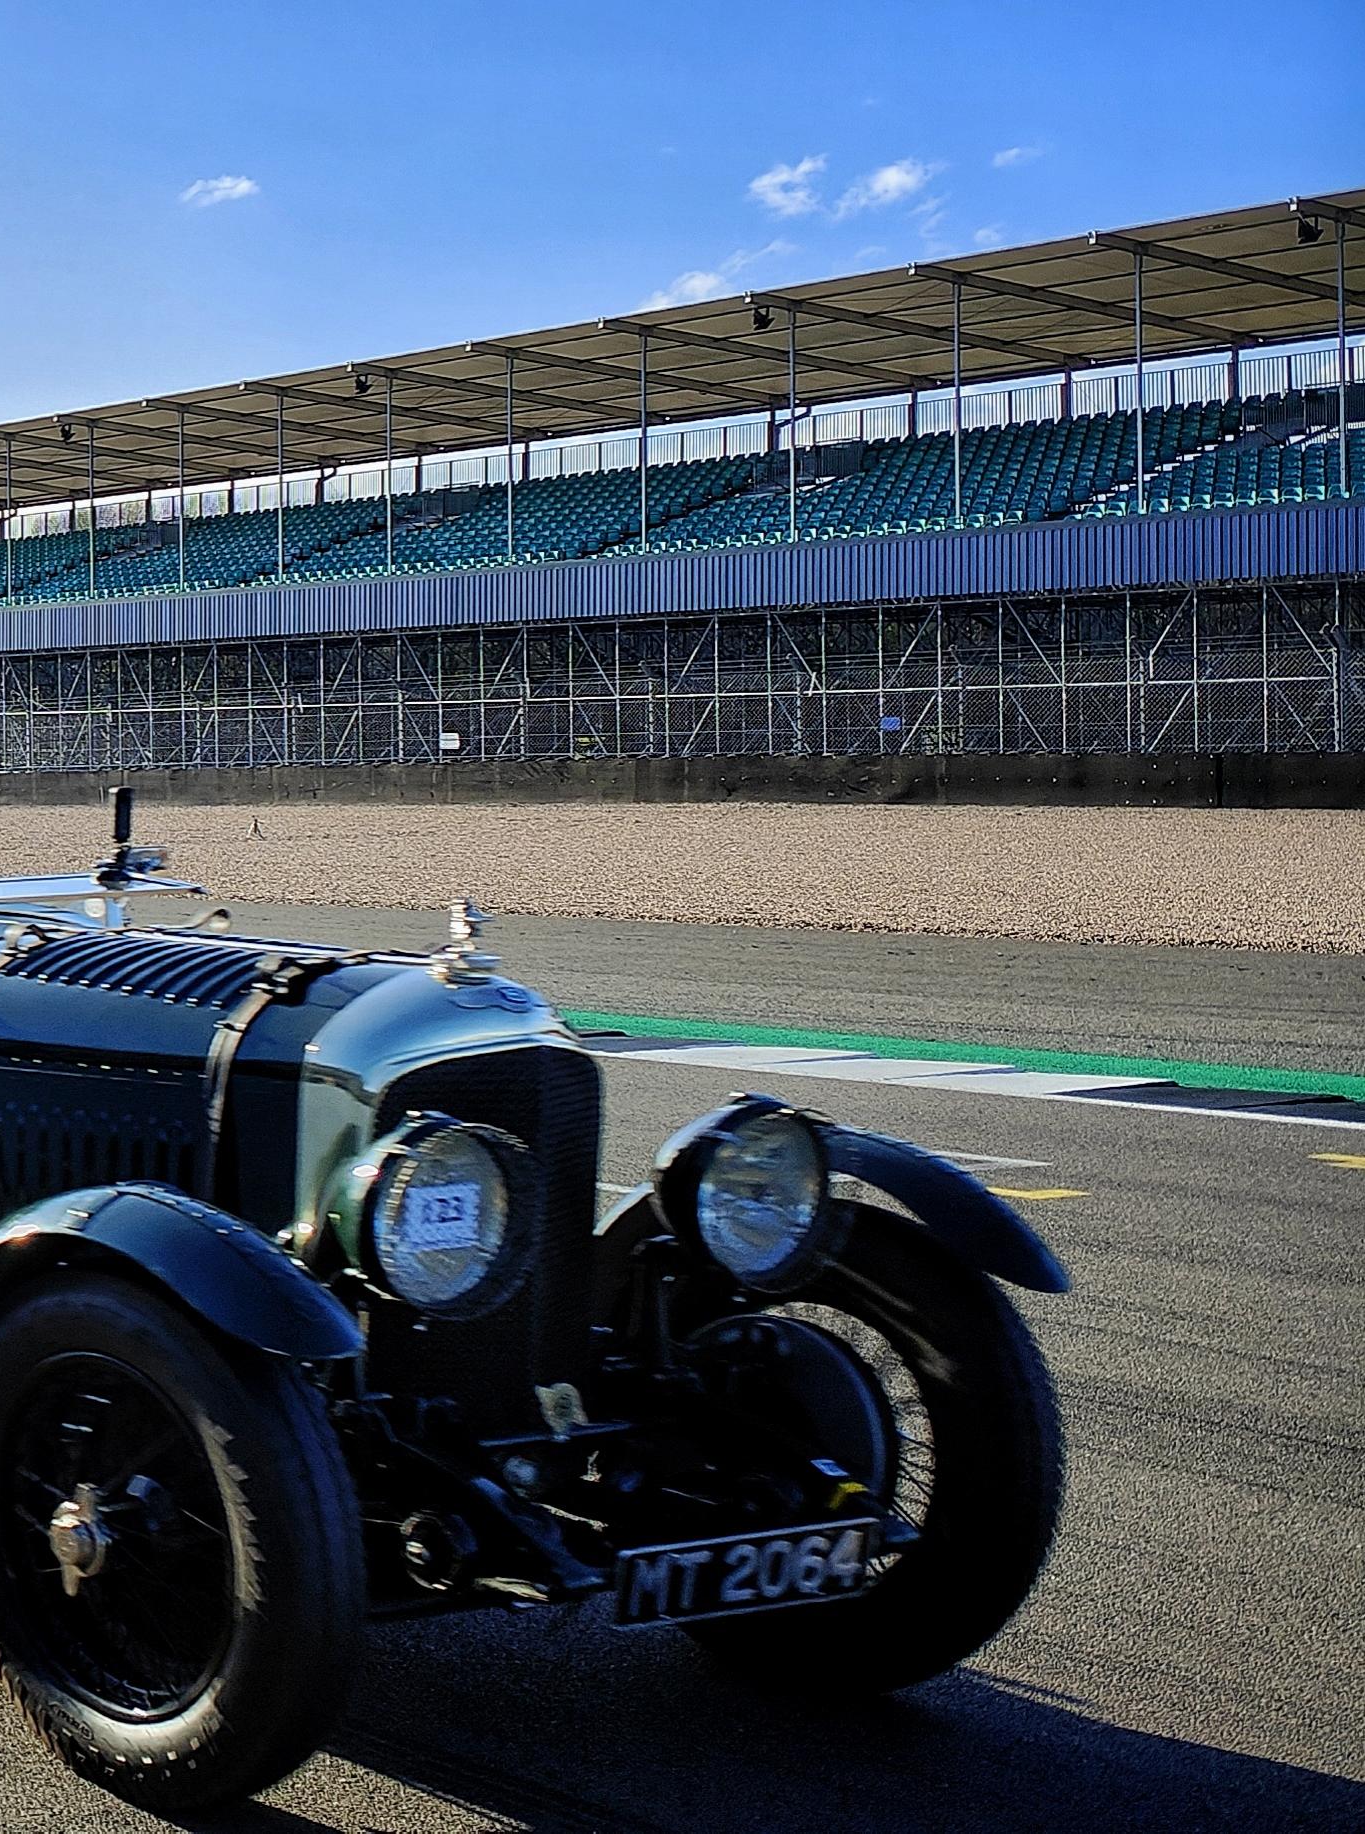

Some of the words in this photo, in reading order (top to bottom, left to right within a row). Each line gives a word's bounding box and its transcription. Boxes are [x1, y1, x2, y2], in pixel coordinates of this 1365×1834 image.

[422, 1195, 465, 1224] 123
[628, 1550, 714, 1618] MT
[722, 1529, 864, 1602] 2064
